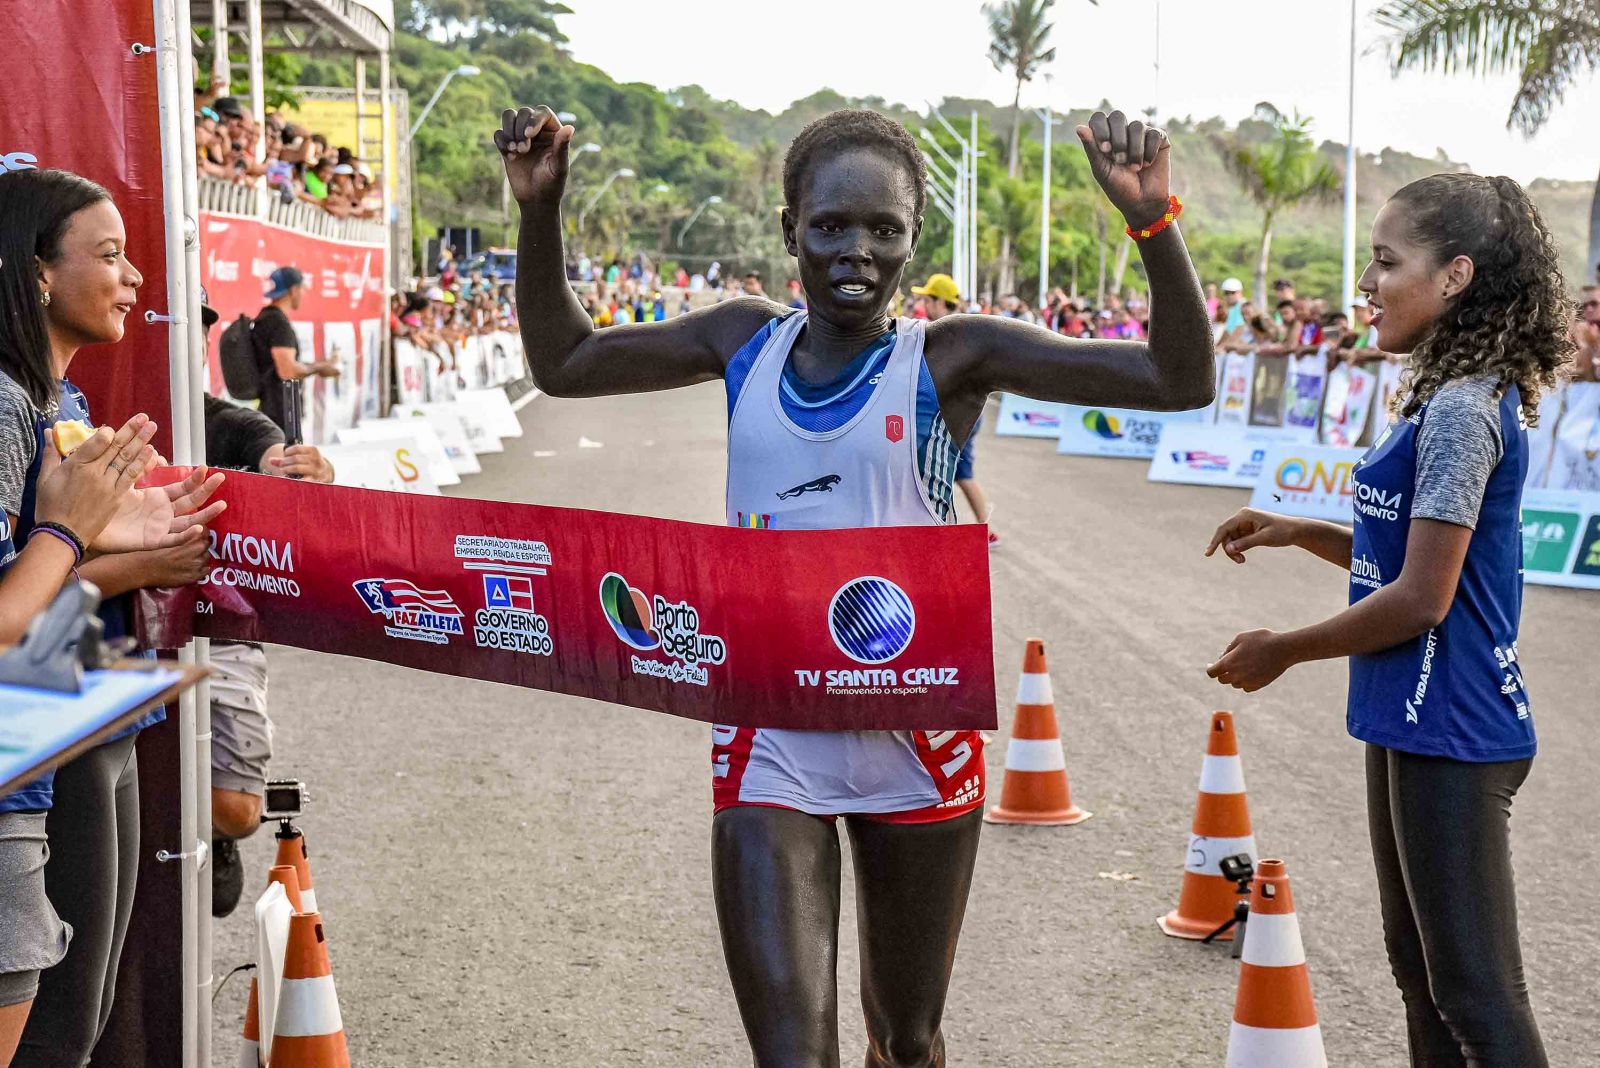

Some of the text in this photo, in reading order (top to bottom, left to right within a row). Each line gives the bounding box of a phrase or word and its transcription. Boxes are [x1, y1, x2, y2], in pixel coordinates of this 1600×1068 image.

[457, 537, 501, 548] SECRETARIA
[500, 541, 510, 549] DO
[456, 546, 493, 557] EMPREGO,
[493, 549, 515, 559] RENDA
[521, 552, 551, 563] ESPORTE
[196, 601, 214, 615] BA
[655, 598, 697, 631] Porto
[477, 611, 548, 634] GOVERNO
[475, 628, 553, 654] DO ESTADO
[663, 624, 724, 664] Seguro
[794, 667, 960, 687] TV SANTA CRUZ
[826, 686, 882, 696] Promovendo
[892, 686, 928, 696] esporte
